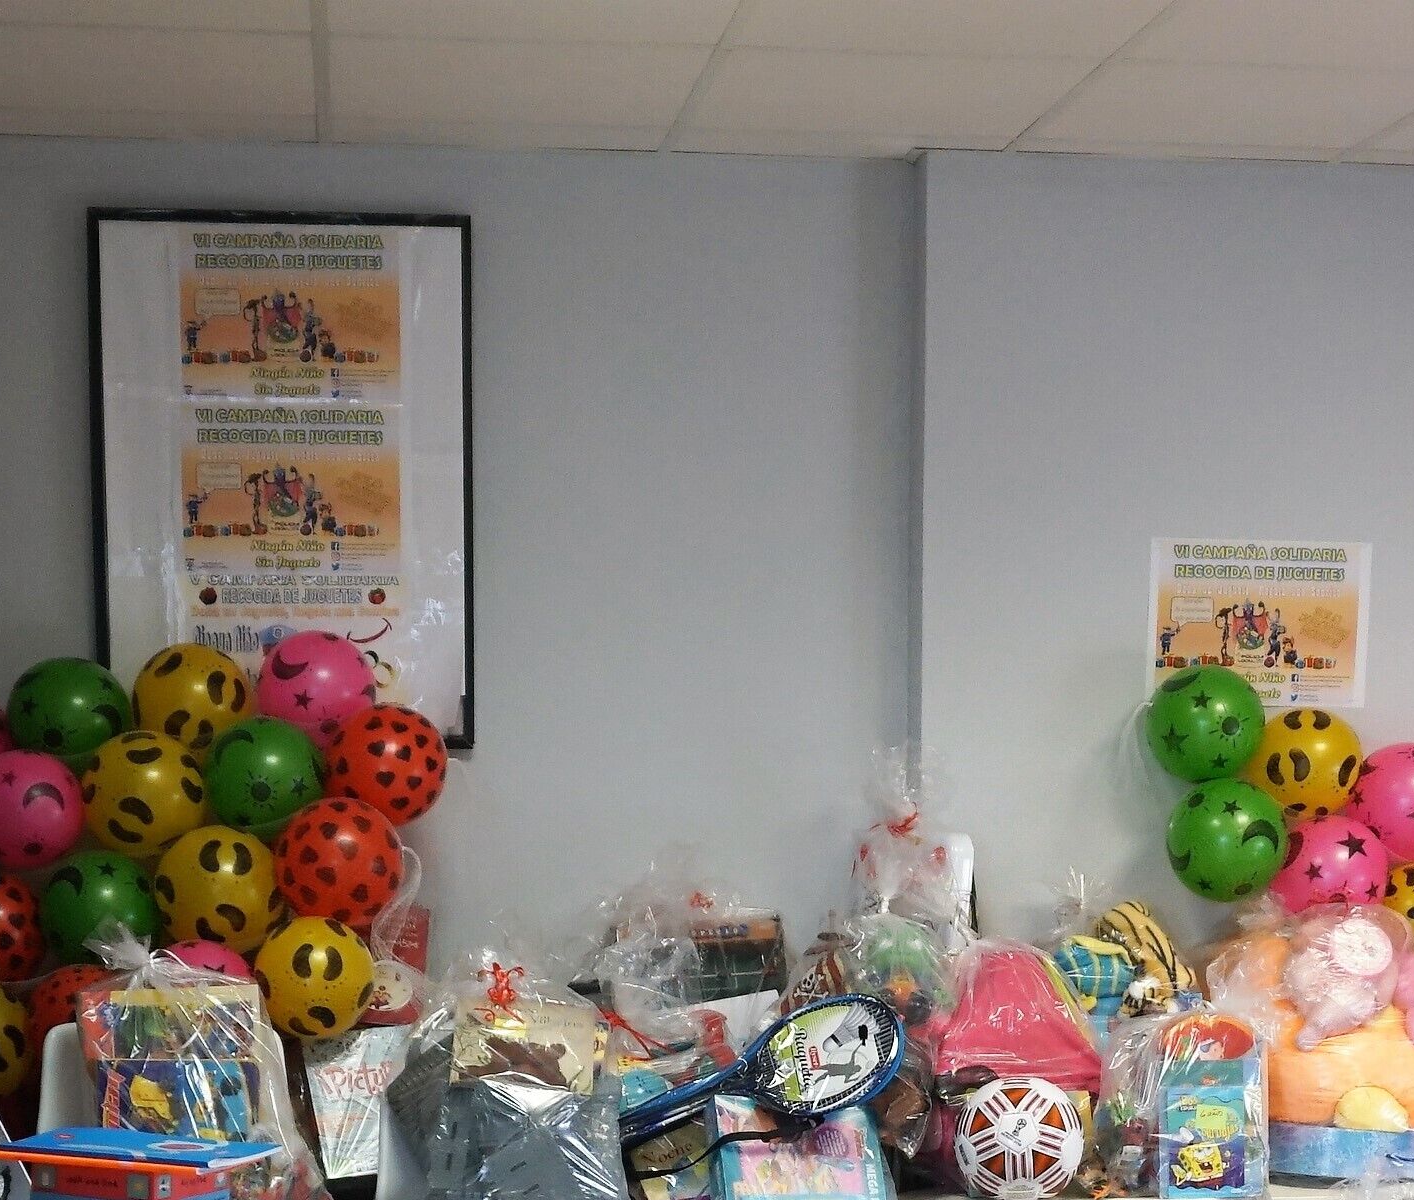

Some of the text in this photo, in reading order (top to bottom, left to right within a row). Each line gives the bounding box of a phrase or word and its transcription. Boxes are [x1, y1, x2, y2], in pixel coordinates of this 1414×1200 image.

[194, 232, 384, 250] VI CAMPAÑA SOLIDARIA
[195, 253, 383, 271] RECOGIDA DE JUGUETES
[195, 407, 384, 425] VI CAMPAÑA SOLIDARIA
[197, 429, 384, 446] RECOGIDA DE JUGUETES
[1174, 544, 1347, 562] VI CAMPAÑA SOLIDARIA
[1175, 565, 1345, 581] RECOGIDA DE JUGUETES
[221, 588, 363, 604] RECOGIDA DE JUGUETES
[1259, 671, 1286, 685] Niño
